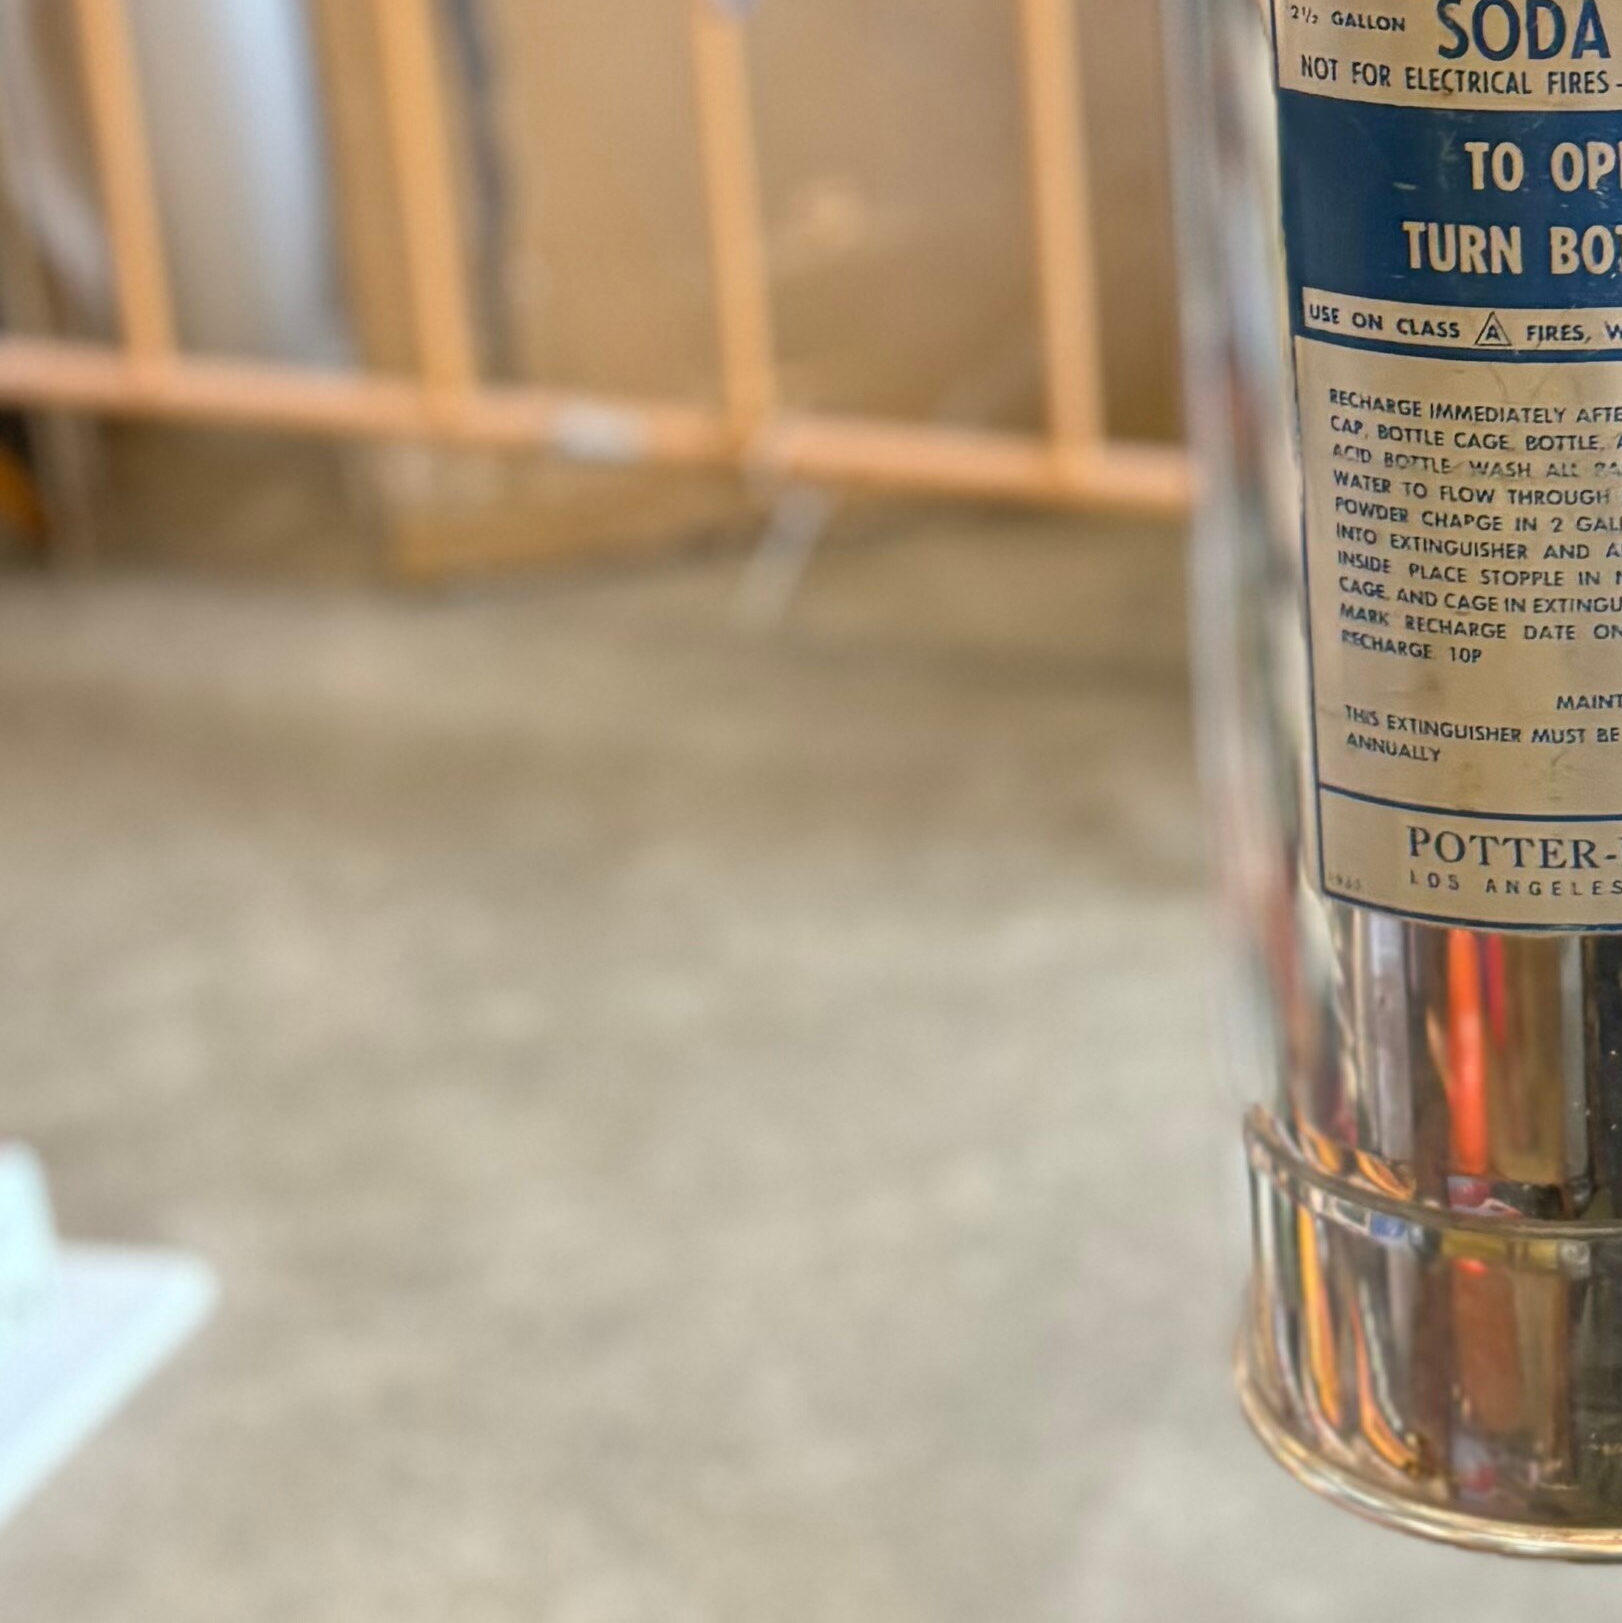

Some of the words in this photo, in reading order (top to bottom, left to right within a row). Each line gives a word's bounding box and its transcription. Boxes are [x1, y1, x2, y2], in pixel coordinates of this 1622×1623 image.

[1331, 10, 1406, 33] GALLON
[1301, 54, 1338, 81] NOT
[1352, 61, 1391, 87] FOR
[1405, 66, 1532, 95] ELECTRICAL
[1464, 141, 1524, 192] TO
[1402, 221, 1521, 275] TURN
[1310, 304, 1339, 324] USE
[1352, 312, 1383, 330] ON
[1396, 318, 1461, 338] CLASS
[1486, 324, 1500, 340] A
[1527, 325, 1591, 344] FIRES,
[1329, 388, 1421, 417] RECHARGE
[1430, 403, 1566, 423] IMMEDIATELY
[1377, 424, 1444, 447] BOTTLE
[1333, 443, 1371, 463] ACID
[1469, 461, 1531, 478] WASH
[1333, 469, 1391, 494] WATER
[1403, 482, 1427, 499] TO
[1440, 486, 1494, 504] FLOW
[1507, 488, 1610, 506] THROUGH
[1335, 496, 1408, 523] POWDER
[1516, 517, 1537, 532] IN
[1551, 518, 1563, 533] 2
[1337, 522, 1377, 545] INTO
[1390, 532, 1528, 560] EXTINGUISHER
[1543, 544, 1590, 560] AND
[1337, 550, 1391, 575] INSIDE
[1408, 562, 1468, 584] PLACE
[1480, 568, 1564, 587] STOPPLE
[1578, 570, 1600, 585] IN
[1397, 588, 1437, 607] AND
[1444, 592, 1499, 612] CAGE
[1504, 597, 1527, 613] IN
[1340, 602, 1390, 627] MARK
[1405, 614, 1507, 640] RECHARGE
[1523, 624, 1576, 641] DATE
[1341, 629, 1433, 660] RECHARGE
[1344, 704, 1380, 726] THIS
[1387, 713, 1522, 744] EXTINGUISHER
[1531, 728, 1587, 744] MUST
[1597, 727, 1619, 743] BE
[1345, 732, 1441, 762] ANNUALLY
[1409, 868, 1460, 891] LOS
